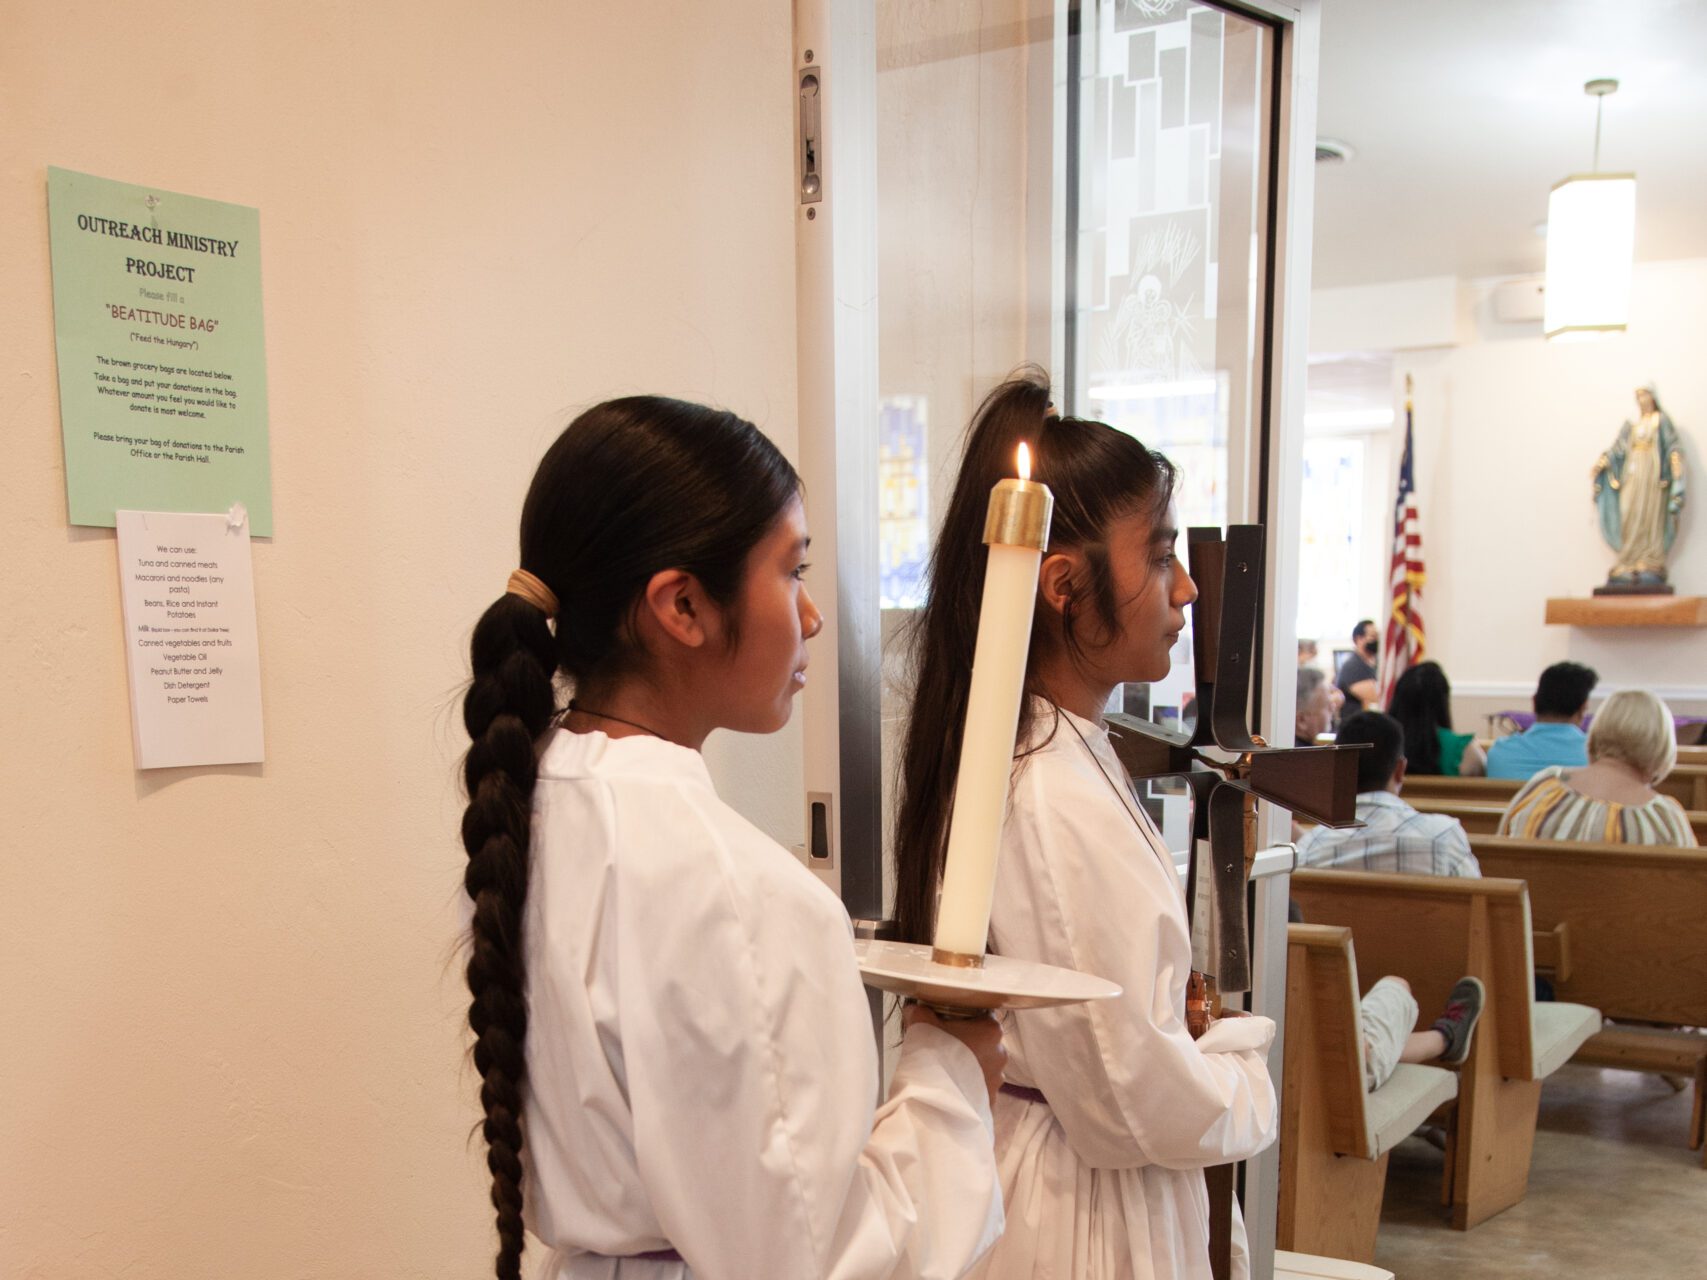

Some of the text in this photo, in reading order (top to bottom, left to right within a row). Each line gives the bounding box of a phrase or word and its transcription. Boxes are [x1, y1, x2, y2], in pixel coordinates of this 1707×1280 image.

[78, 214, 238, 258] OUTREACH MINISTRY
[126, 258, 195, 283] PROJECT
[140, 288, 164, 300] Please
[166, 292, 178, 302] fill
[106, 304, 219, 332] "BEATITUDE BAG"
[153, 336, 165, 344] the
[97, 356, 109, 365] The
[111, 358, 131, 368] brown
[133, 362, 158, 373] grocery
[160, 364, 174, 374] bags
[189, 368, 212, 378] located
[214, 371, 233, 380] below.
[94, 372, 110, 382] Take
[117, 376, 129, 386] bag
[131, 377, 142, 386] and
[144, 379, 155, 388] put
[156, 381, 170, 390] your
[173, 382, 203, 392] donations
[205, 385, 211, 393] in
[213, 386, 223, 395] the
[97, 386, 130, 397] Whatever
[132, 391, 154, 399] amount
[156, 393, 168, 402] you
[169, 395, 182, 403] feel
[184, 397, 195, 406] you
[197, 397, 215, 407] would
[216, 399, 227, 408] like
[130, 404, 151, 412] donate
[161, 406, 176, 415] most
[178, 409, 206, 418] welcome.
[93, 432, 244, 454] Please bring your bag of donations to the Parish
[130, 449, 152, 458] Office
[162, 451, 173, 460] the
[175, 453, 194, 462] Parish
[197, 455, 210, 463] Hall.
[155, 560, 169, 568] and
[170, 560, 197, 568] canned
[210, 575, 224, 584] (any
[169, 586, 190, 594] pasta)
[163, 654, 196, 662] Vegetable
[208, 668, 222, 676] Jelly
[178, 682, 210, 690] Detergent
[167, 696, 186, 704] Paper
